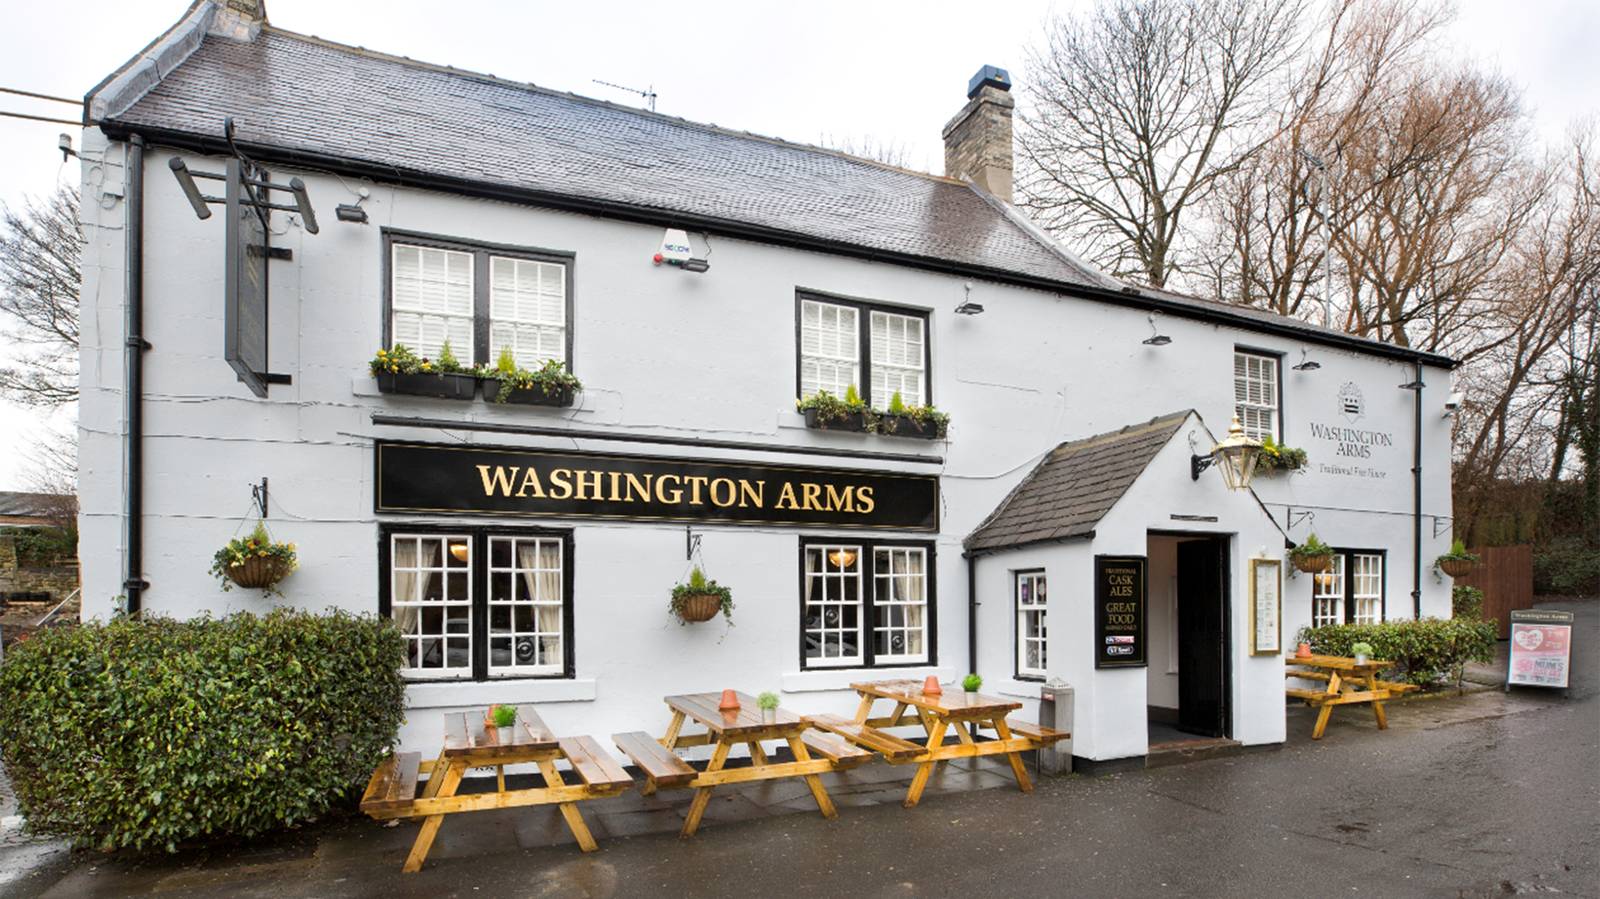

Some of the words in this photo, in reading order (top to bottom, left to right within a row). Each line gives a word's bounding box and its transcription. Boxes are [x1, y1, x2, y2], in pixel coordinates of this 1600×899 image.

[1310, 422, 1393, 446] WASHINGTON
[1336, 442, 1371, 459] ARMS
[476, 464, 766, 509] WASHINGTON
[774, 480, 875, 513] ARMS
[1109, 575, 1133, 585] CASK
[1110, 586, 1133, 596] ALES
[1106, 602, 1136, 613] GREAT
[1108, 614, 1135, 624] FOOD
